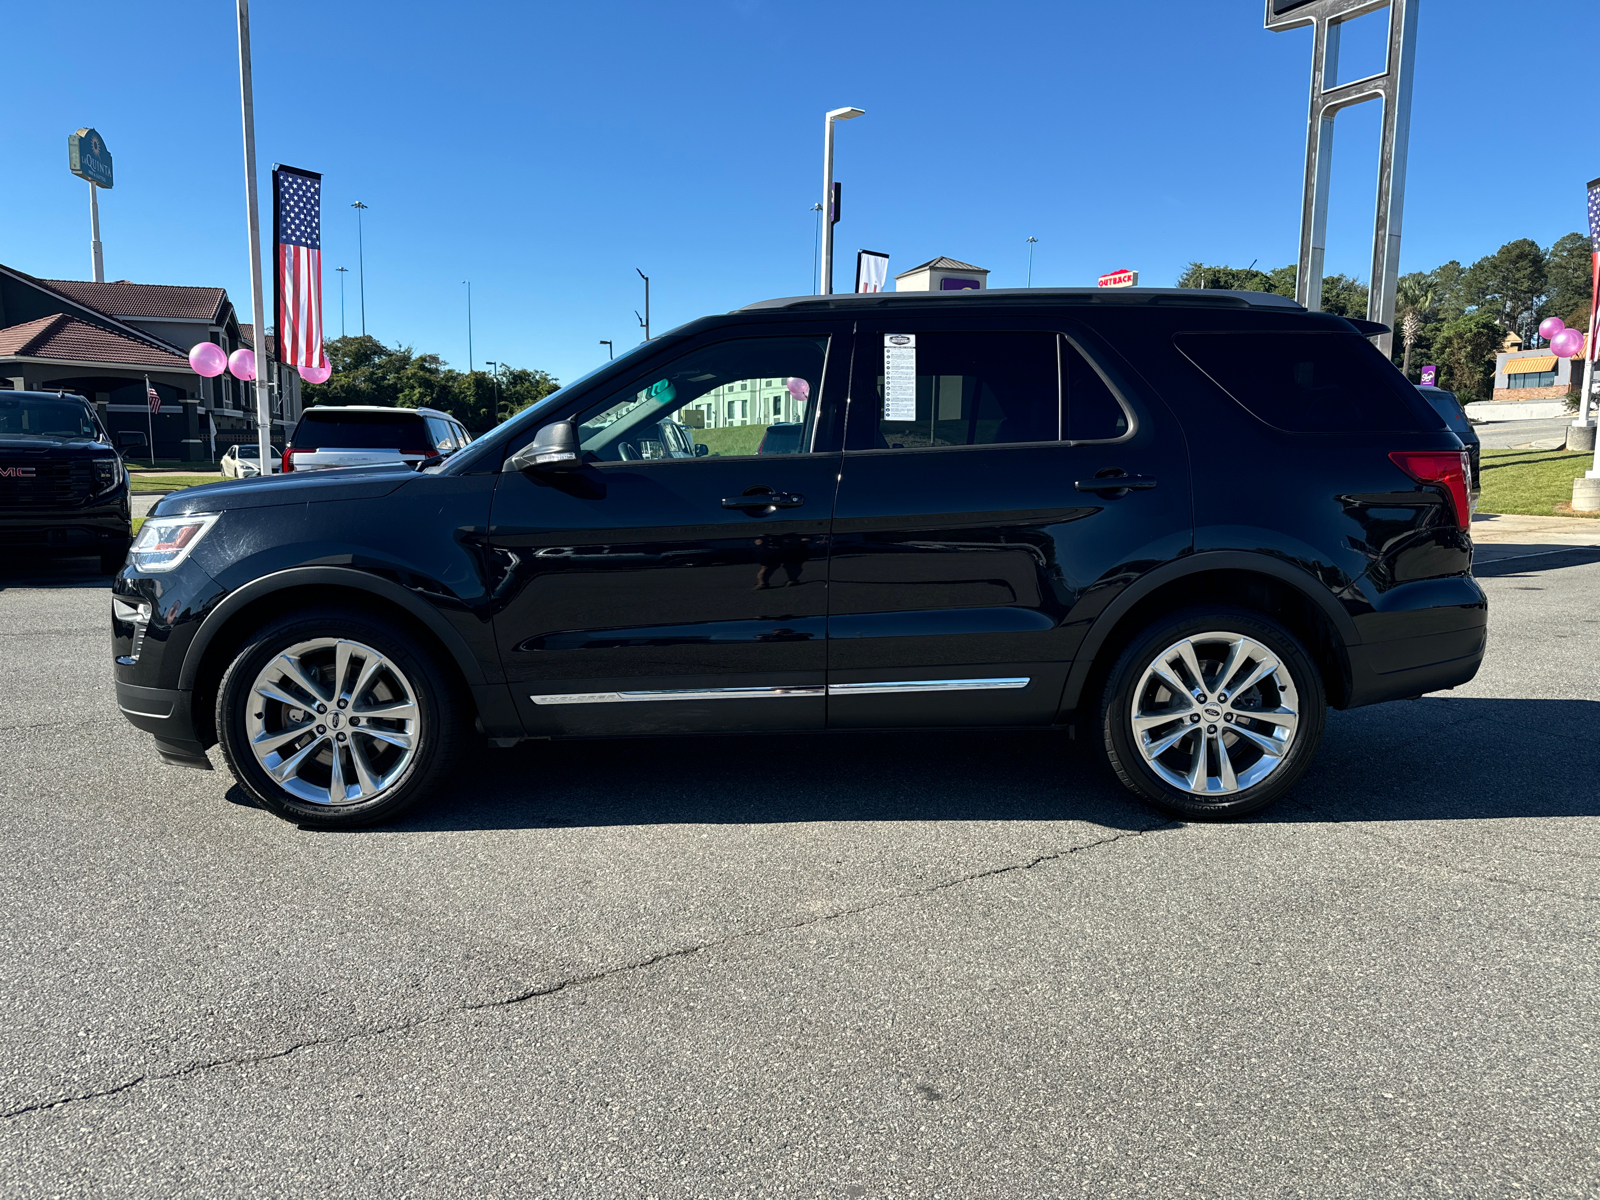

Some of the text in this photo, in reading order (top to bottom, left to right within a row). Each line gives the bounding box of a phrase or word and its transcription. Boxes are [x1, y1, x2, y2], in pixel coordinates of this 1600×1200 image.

[1098, 274, 1133, 287] OUTBACK
[0, 467, 36, 477] MC
[1215, 614, 1276, 635] COUNTRY
[539, 694, 617, 702] EXPLORER
